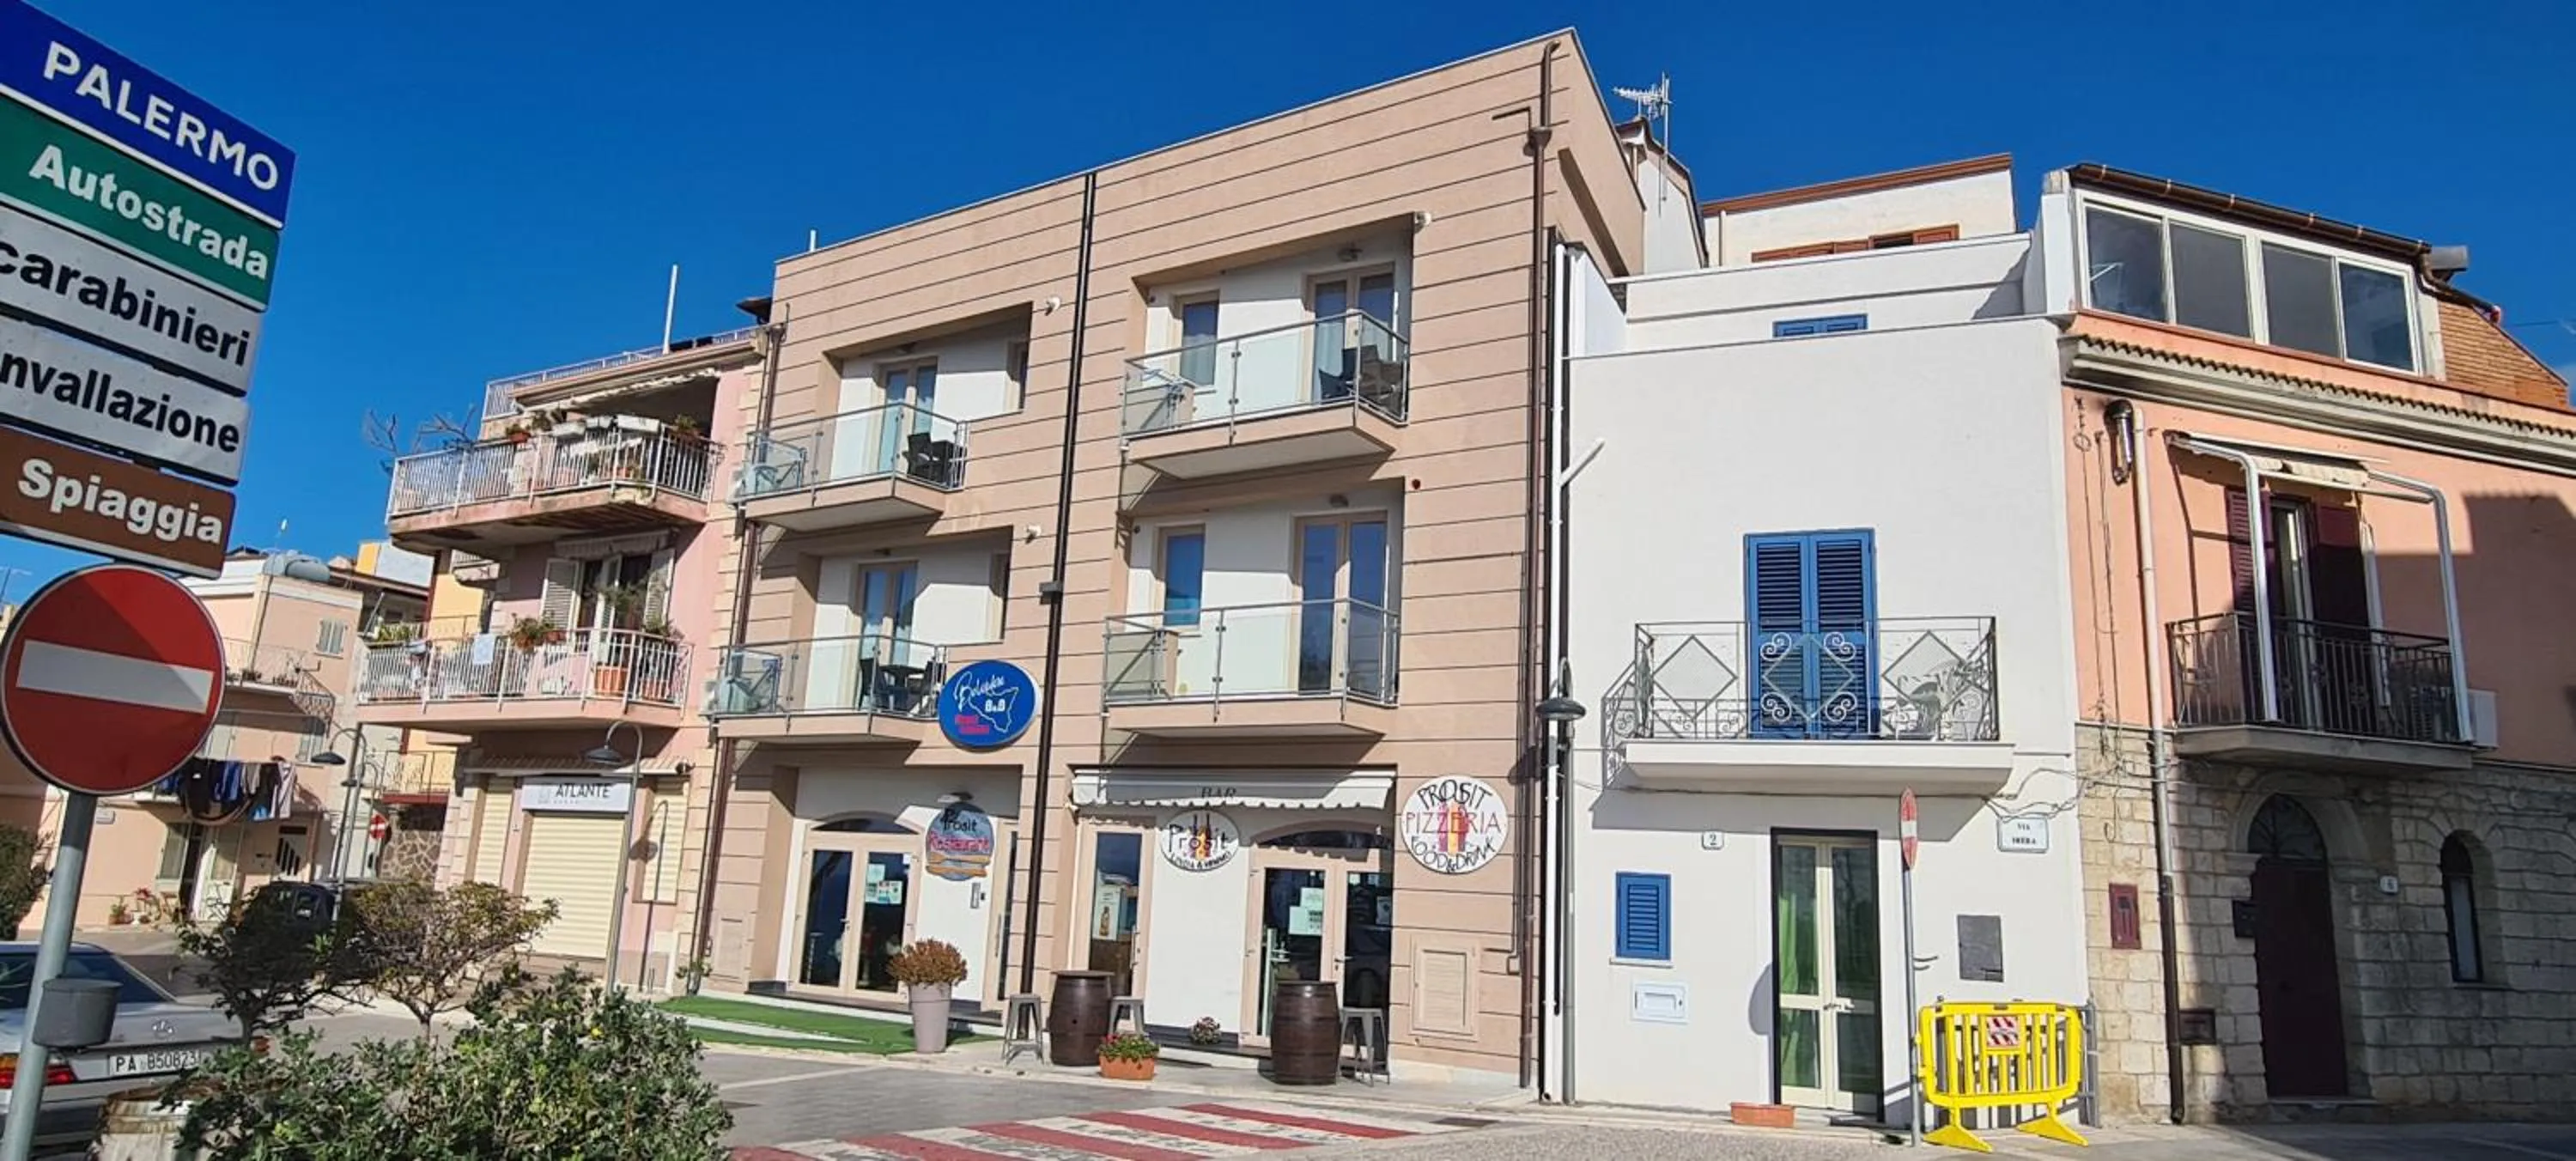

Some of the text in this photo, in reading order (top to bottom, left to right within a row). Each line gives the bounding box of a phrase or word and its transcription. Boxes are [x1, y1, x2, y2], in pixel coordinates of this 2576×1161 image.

[44, 40, 278, 191] PALERMO
[28, 144, 268, 279] Autostrada
[18, 458, 223, 544] Spiaggia
[556, 782, 611, 798] ATLANTE
[1200, 786, 1236, 799] BAR
[1417, 779, 1493, 810] PROSIT
[941, 807, 977, 832] Prosit
[1406, 811, 1502, 834] PIZZERIA
[1169, 824, 1228, 854] Prosit
[1710, 833, 1717, 846] 2
[115, 1055, 137, 1073] PA
